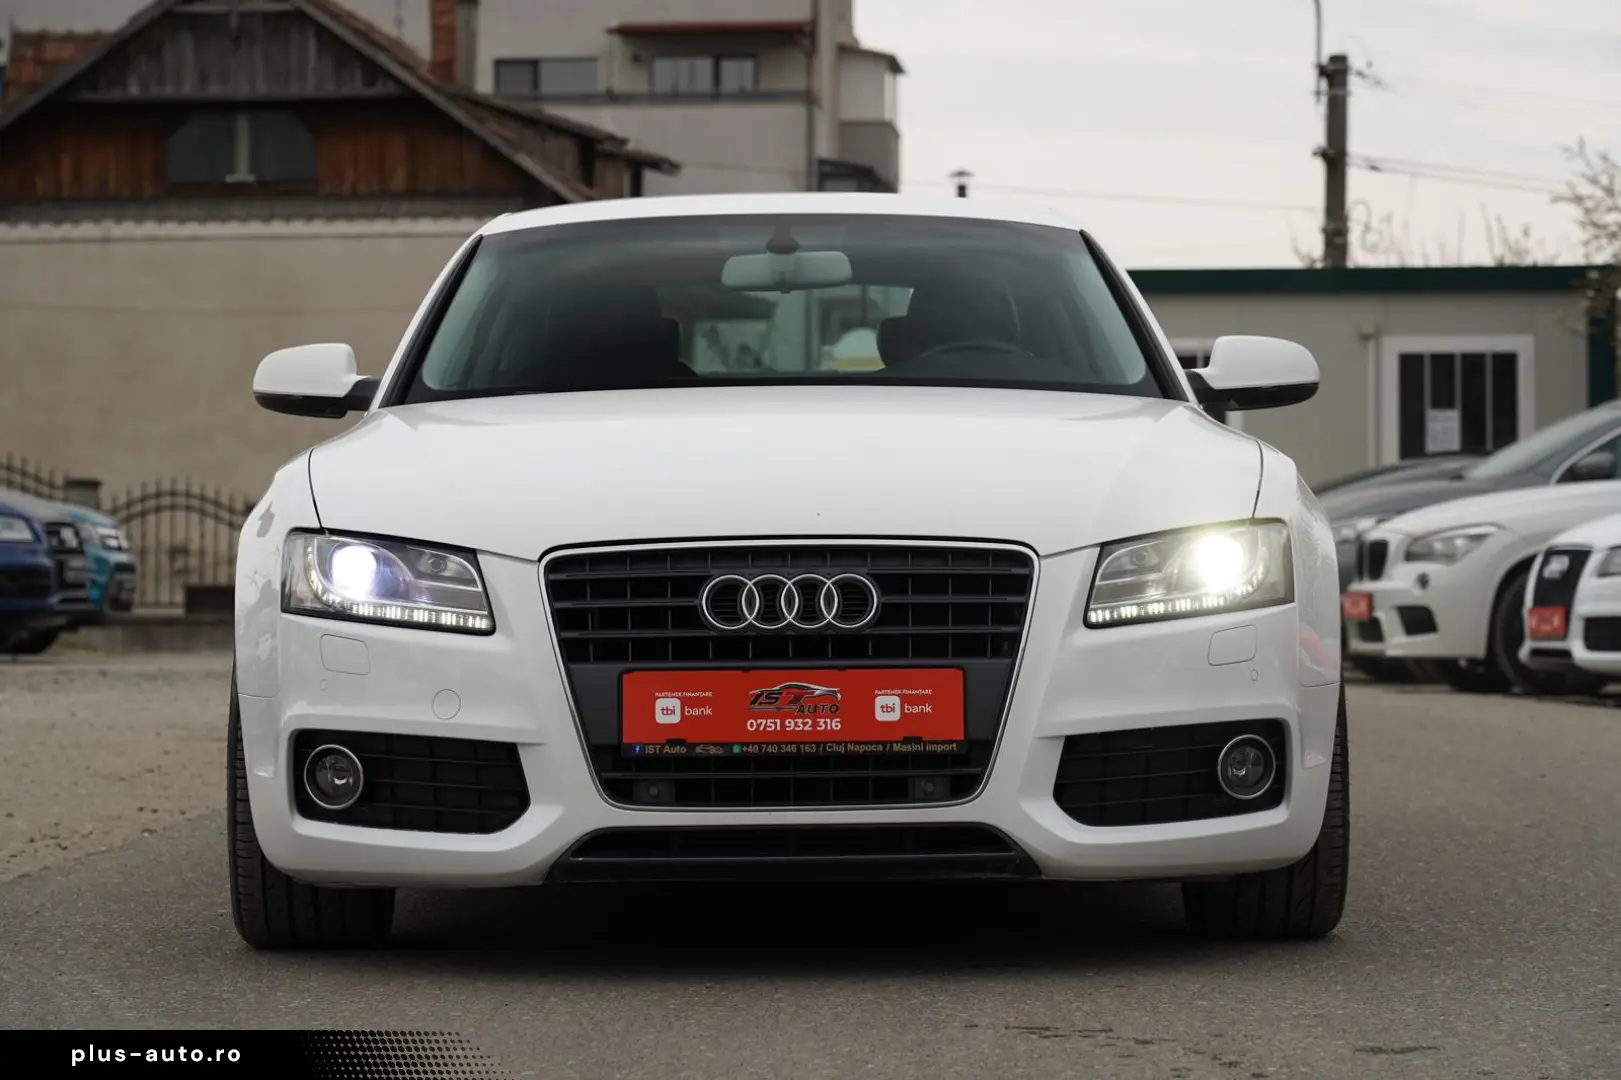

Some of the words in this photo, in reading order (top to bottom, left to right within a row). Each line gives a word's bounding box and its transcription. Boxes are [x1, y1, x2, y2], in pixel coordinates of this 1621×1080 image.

[660, 706, 676, 716] tbi
[684, 705, 713, 716] bank
[795, 703, 840, 714] AUTO
[880, 703, 896, 713] tbi
[904, 703, 933, 713] bank
[746, 718, 781, 731] 0751
[785, 718, 813, 731] 932
[816, 718, 842, 731] 316
[645, 745, 661, 754] IST
[663, 745, 687, 754] Auto
[742, 744, 759, 753] +40
[761, 744, 778, 753] 740
[780, 744, 797, 753] 346
[799, 744, 817, 753] 163
[825, 743, 845, 754] Cluj
[847, 743, 883, 753] Napoca
[926, 742, 958, 753] import
